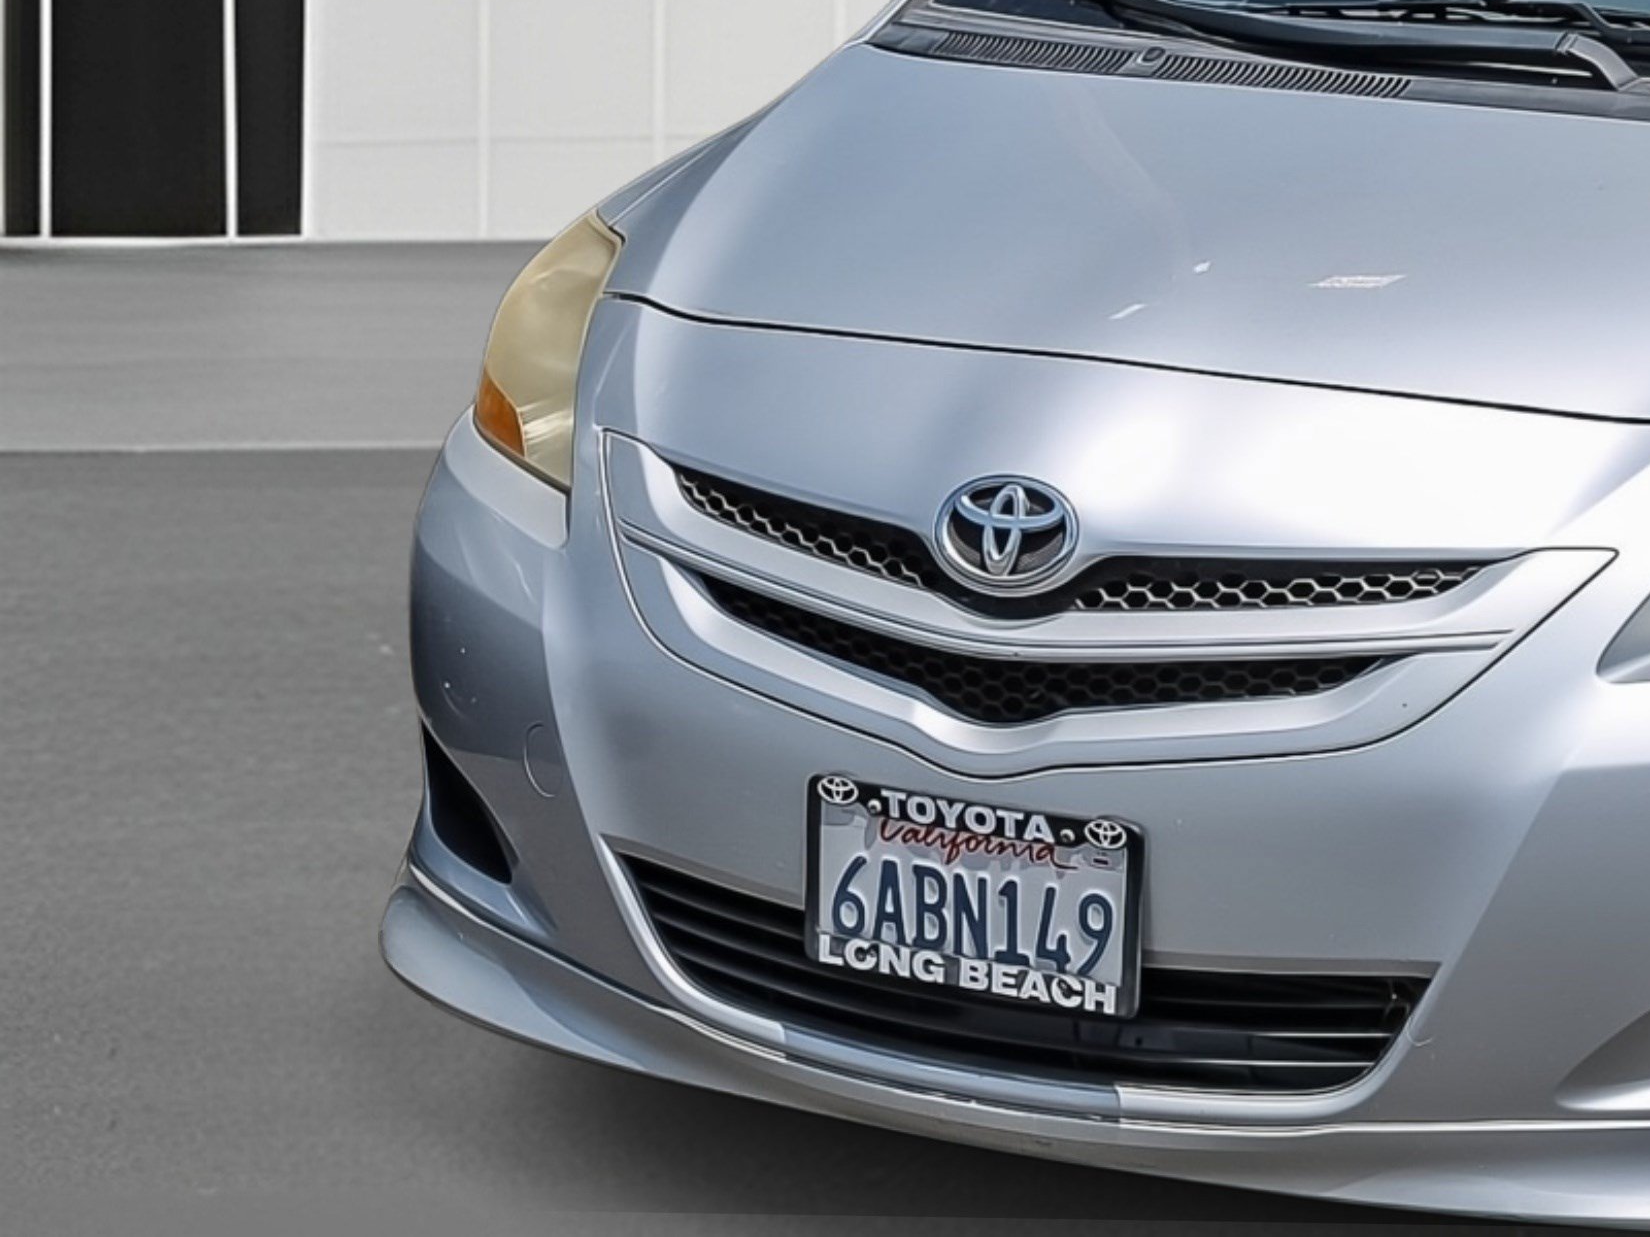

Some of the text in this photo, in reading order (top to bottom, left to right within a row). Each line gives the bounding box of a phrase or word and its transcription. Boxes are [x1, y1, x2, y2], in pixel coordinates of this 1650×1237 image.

[880, 788, 1055, 844] TOYOTA
[831, 855, 1114, 979] 6ABN149
[818, 934, 1118, 1014] LONG BEACH
